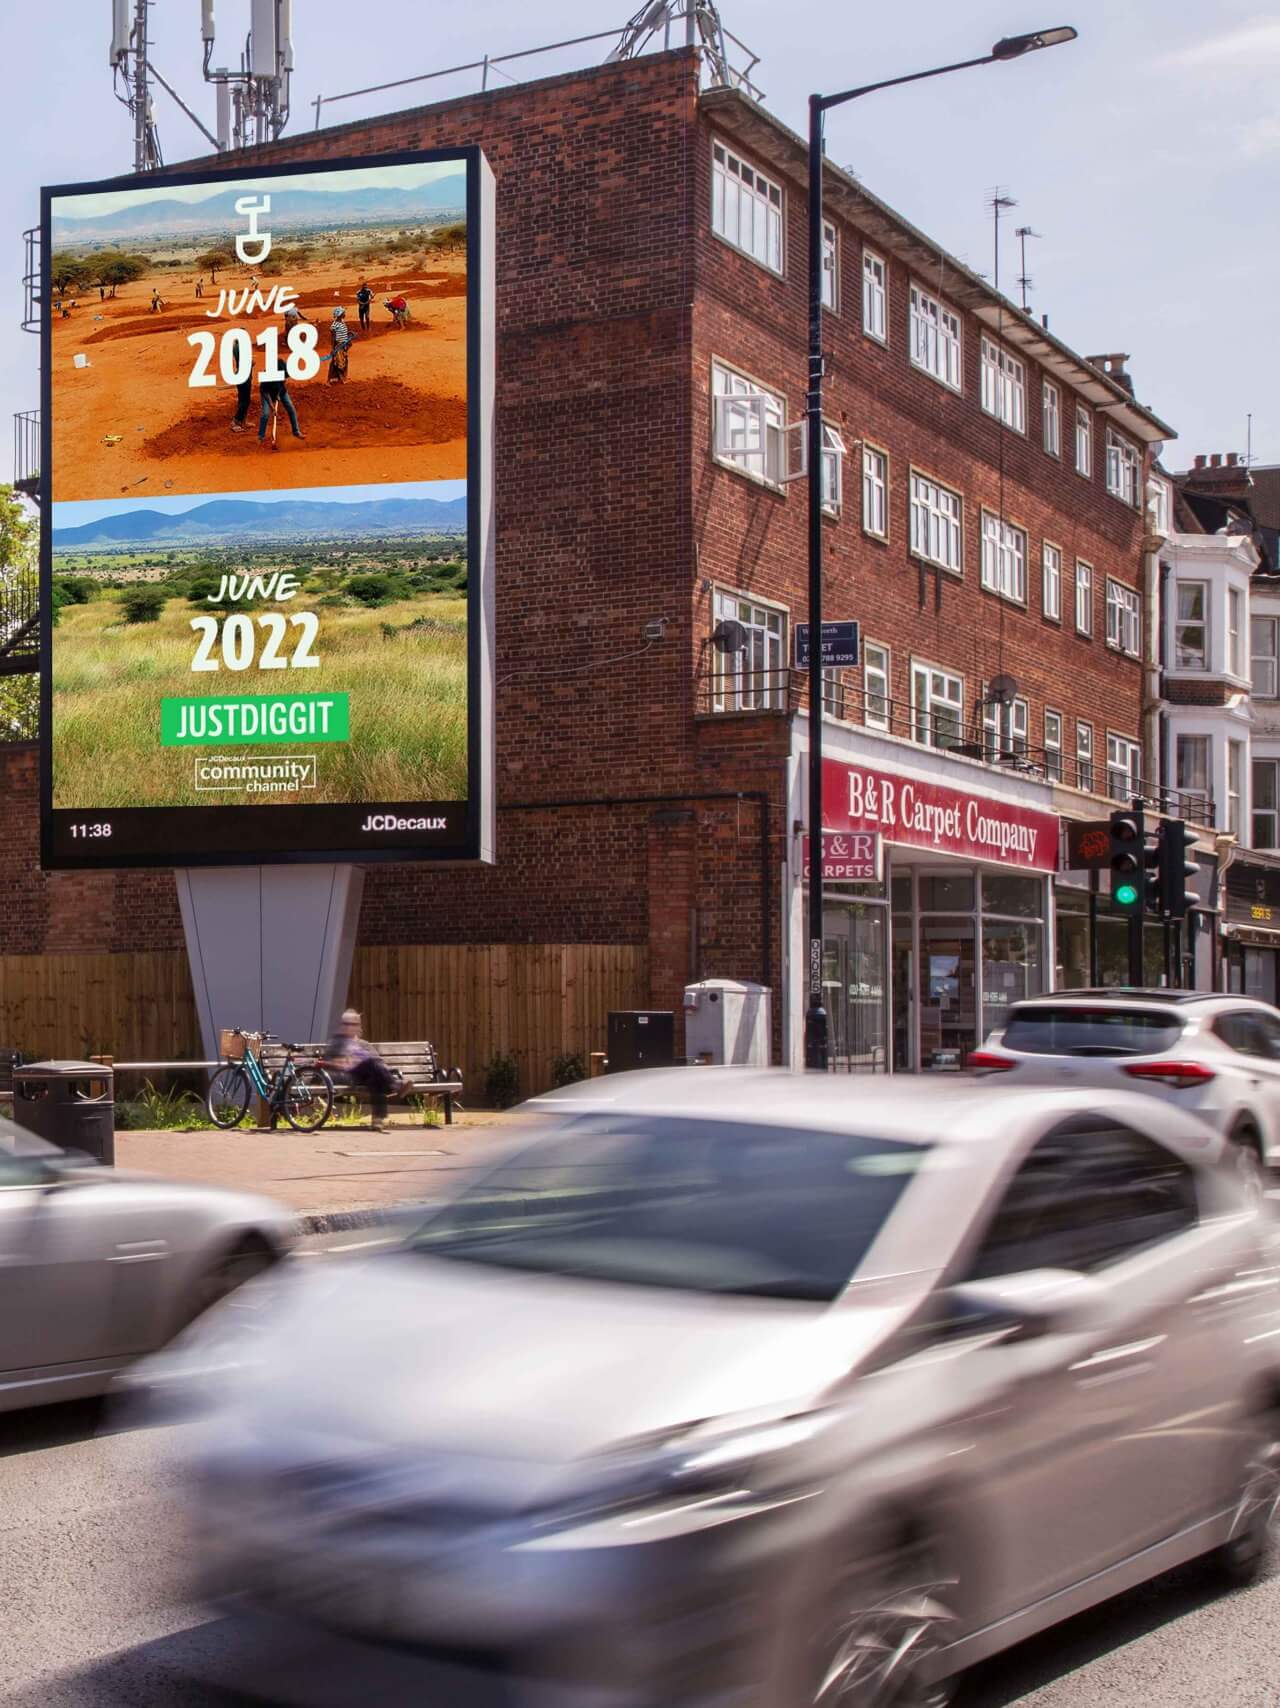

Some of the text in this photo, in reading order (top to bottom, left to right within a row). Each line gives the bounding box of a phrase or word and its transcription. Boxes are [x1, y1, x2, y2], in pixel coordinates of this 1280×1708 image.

[206, 285, 300, 318] JUNE
[187, 323, 321, 388] 2018
[207, 572, 302, 603] JUNE
[190, 611, 321, 672] 2022
[176, 701, 334, 738] JUSTDIGGIT
[199, 759, 311, 781] community
[246, 778, 299, 792] channel
[70, 823, 112, 838] 11:38
[361, 814, 448, 832] JCDecaux
[900, 784, 962, 844] Carpet
[966, 800, 1039, 862] Company
[803, 865, 874, 877] CRPETS
